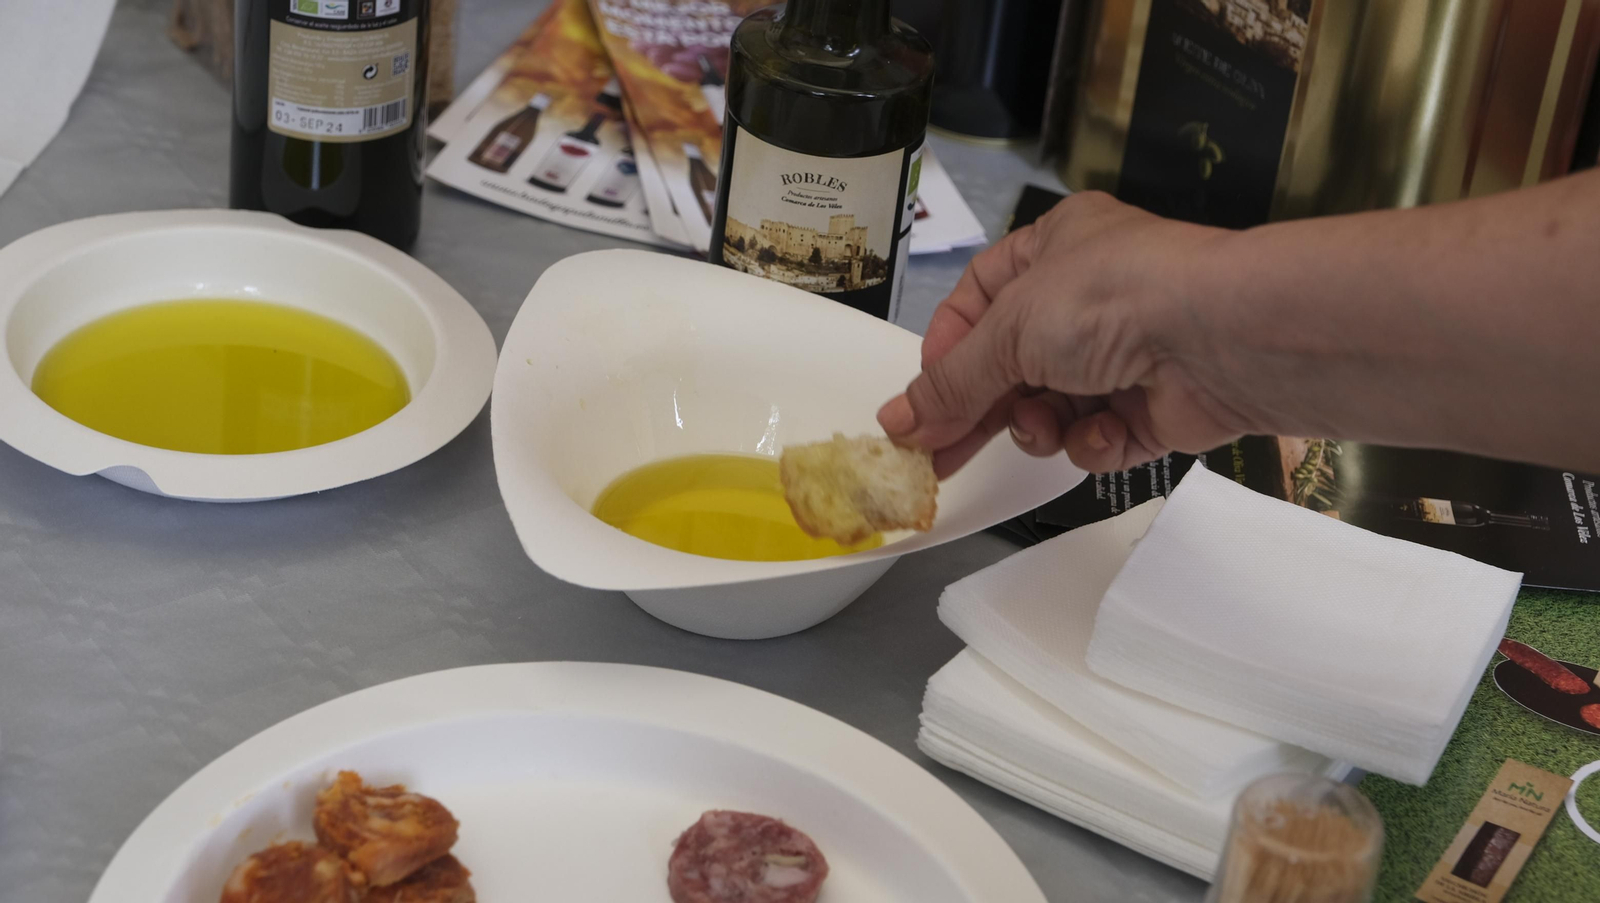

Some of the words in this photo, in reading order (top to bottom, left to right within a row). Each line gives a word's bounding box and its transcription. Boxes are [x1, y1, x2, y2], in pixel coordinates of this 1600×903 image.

[780, 172, 848, 192] ROBLES
[781, 195, 807, 206] Comarca
[787, 190, 812, 200] Productos
[1562, 472, 1577, 502] Comarca
[1582, 479, 1599, 511] Productos
[1570, 502, 1583, 512] de
[1573, 512, 1586, 524] Los
[1577, 526, 1591, 544] Vélez
